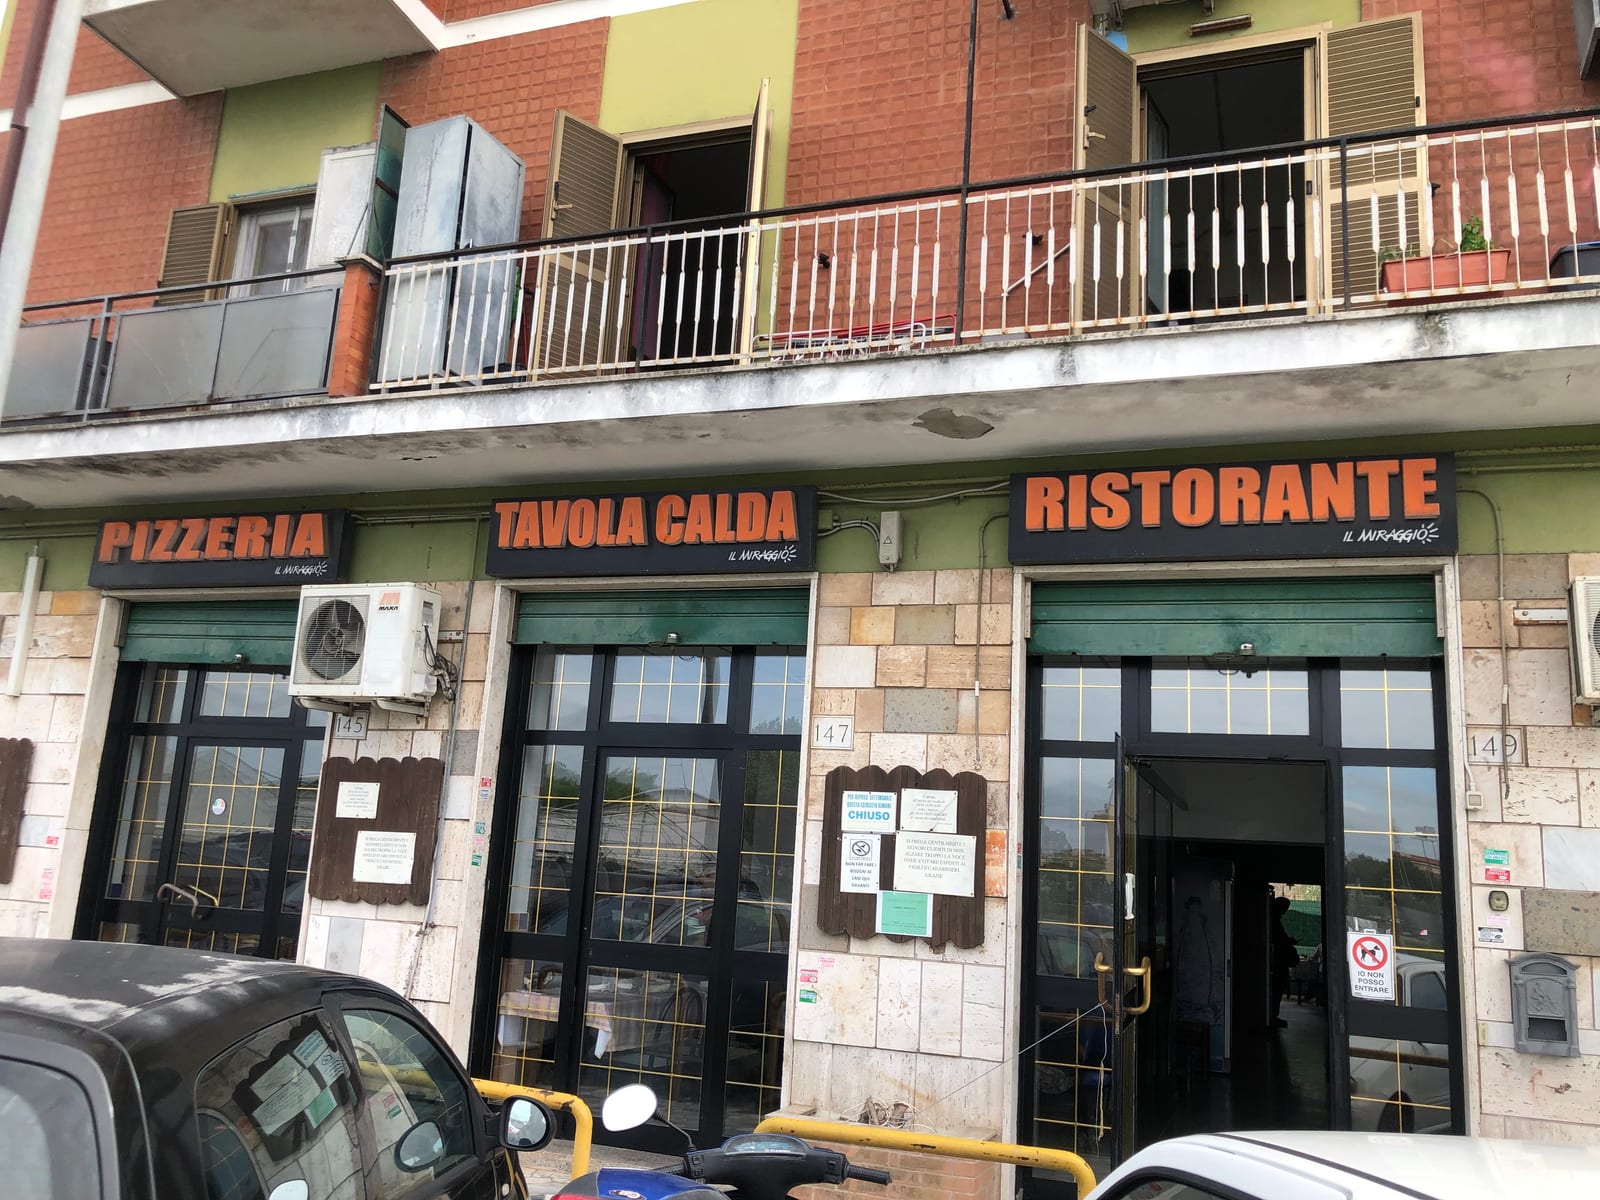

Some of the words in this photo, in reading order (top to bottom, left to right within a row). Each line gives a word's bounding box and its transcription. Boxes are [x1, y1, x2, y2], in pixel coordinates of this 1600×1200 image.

[1025, 457, 1441, 531] RISTORANTE
[495, 496, 648, 549] TAVOLA
[655, 490, 798, 545] CALDA
[98, 512, 328, 563] PIZZERIA
[1342, 530, 1354, 543] IL
[1356, 525, 1431, 544] MIRAGGIO
[728, 551, 737, 561] IL
[738, 547, 791, 562] MIRAGGIO
[274, 566, 282, 575] IL
[282, 563, 324, 576] MIRAGGIO
[336, 716, 364, 734] 145
[815, 723, 849, 743] 147
[1471, 733, 1518, 758] 149
[848, 810, 890, 821] CHIUSO
[1358, 978, 1385, 986] POSSO
[1367, 971, 1385, 979] NON
[1354, 984, 1390, 994] ENTRARE
